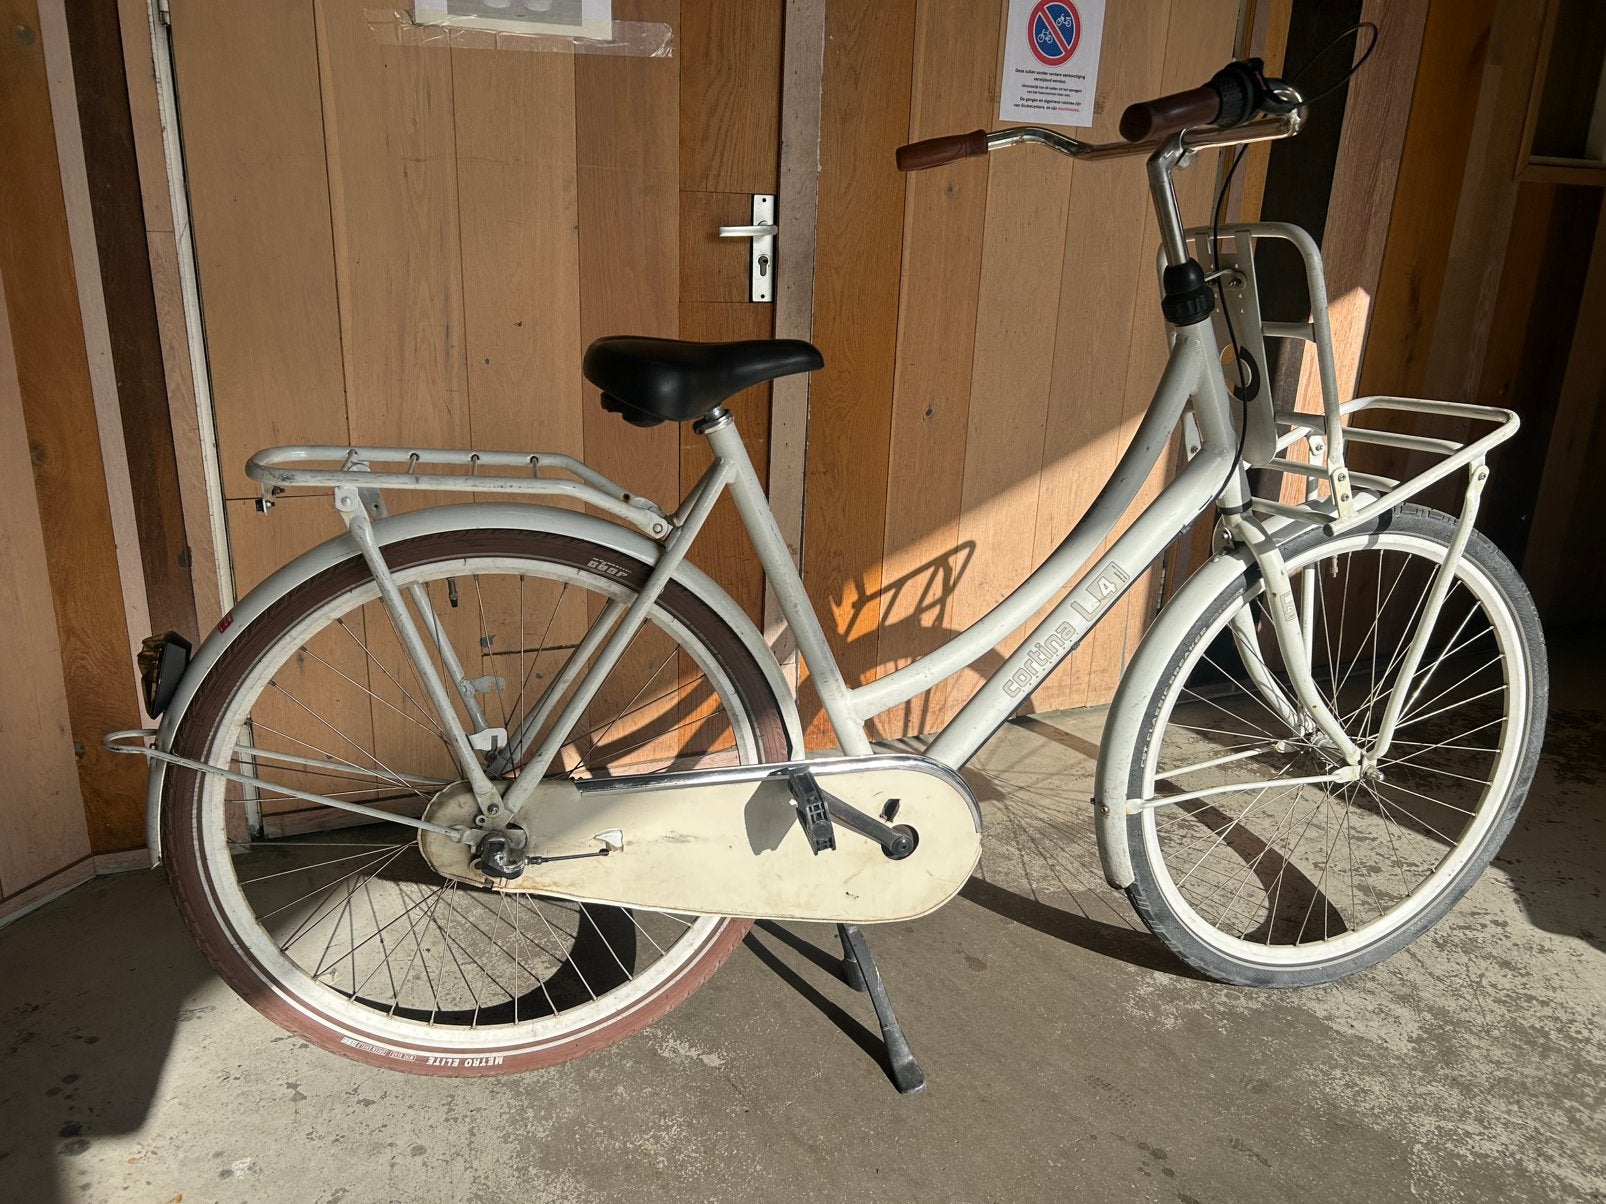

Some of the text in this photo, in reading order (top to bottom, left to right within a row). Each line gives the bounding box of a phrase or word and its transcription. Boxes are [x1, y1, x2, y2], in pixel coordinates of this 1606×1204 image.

[1002, 621, 1076, 698] cortina
[1147, 687, 1168, 741] CLASSIC
[1169, 627, 1206, 685] BREAKER
[426, 1056, 504, 1067] METRO ELITE
